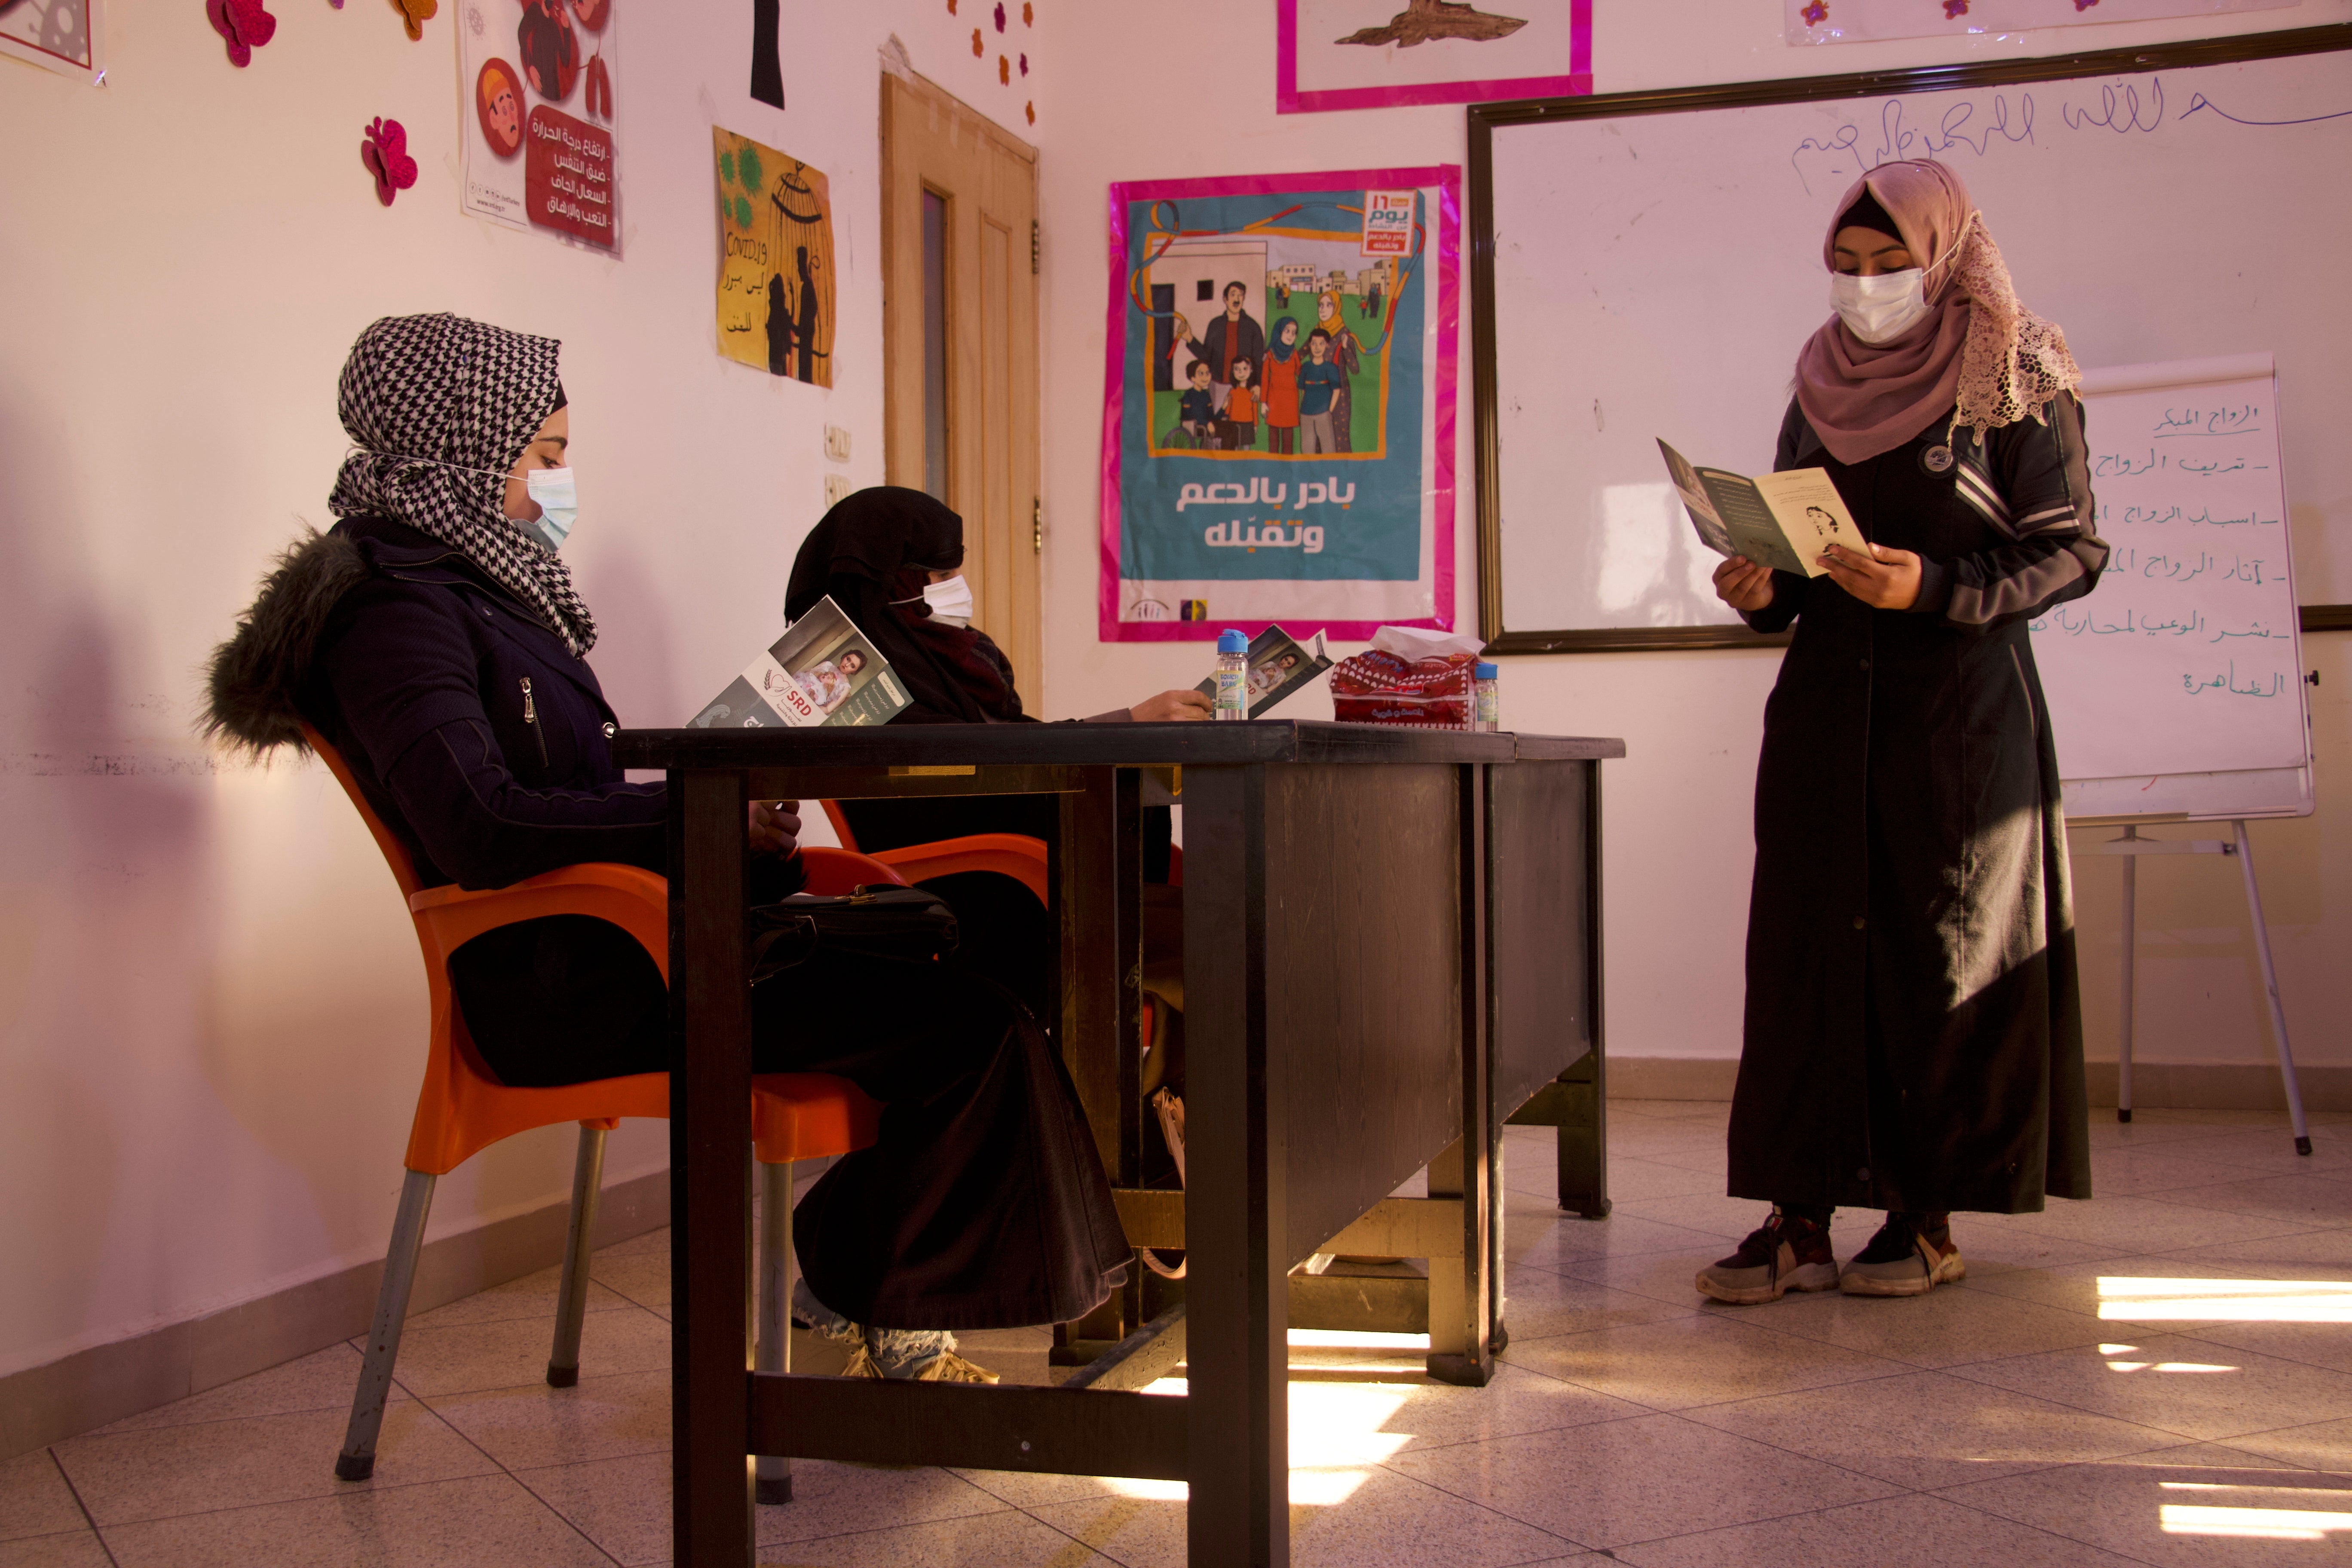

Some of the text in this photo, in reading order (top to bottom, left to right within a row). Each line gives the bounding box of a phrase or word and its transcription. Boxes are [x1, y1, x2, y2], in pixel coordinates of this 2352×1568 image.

[533, 117, 606, 161] ارتفاع درجة الحرارة
[554, 154, 606, 183] ضيق التنفس
[551, 175, 606, 205] السعال الجاف
[547, 196, 607, 227] التعب والإرهاق
[1369, 210, 1408, 224] يوم
[2153, 405, 2257, 432] الزواج المبكر
[2095, 448, 2245, 477] تعريف الزواج
[1176, 476, 1355, 512] بادر بالدعم
[2124, 505, 2180, 523] الزواج
[2101, 548, 2134, 582] المب
[2144, 552, 2213, 582] الزواج
[2141, 609, 2204, 636] الوعي
[2209, 622, 2269, 643] نشر
[781, 698, 802, 722] سوريا
[787, 690, 812, 716] SRD
